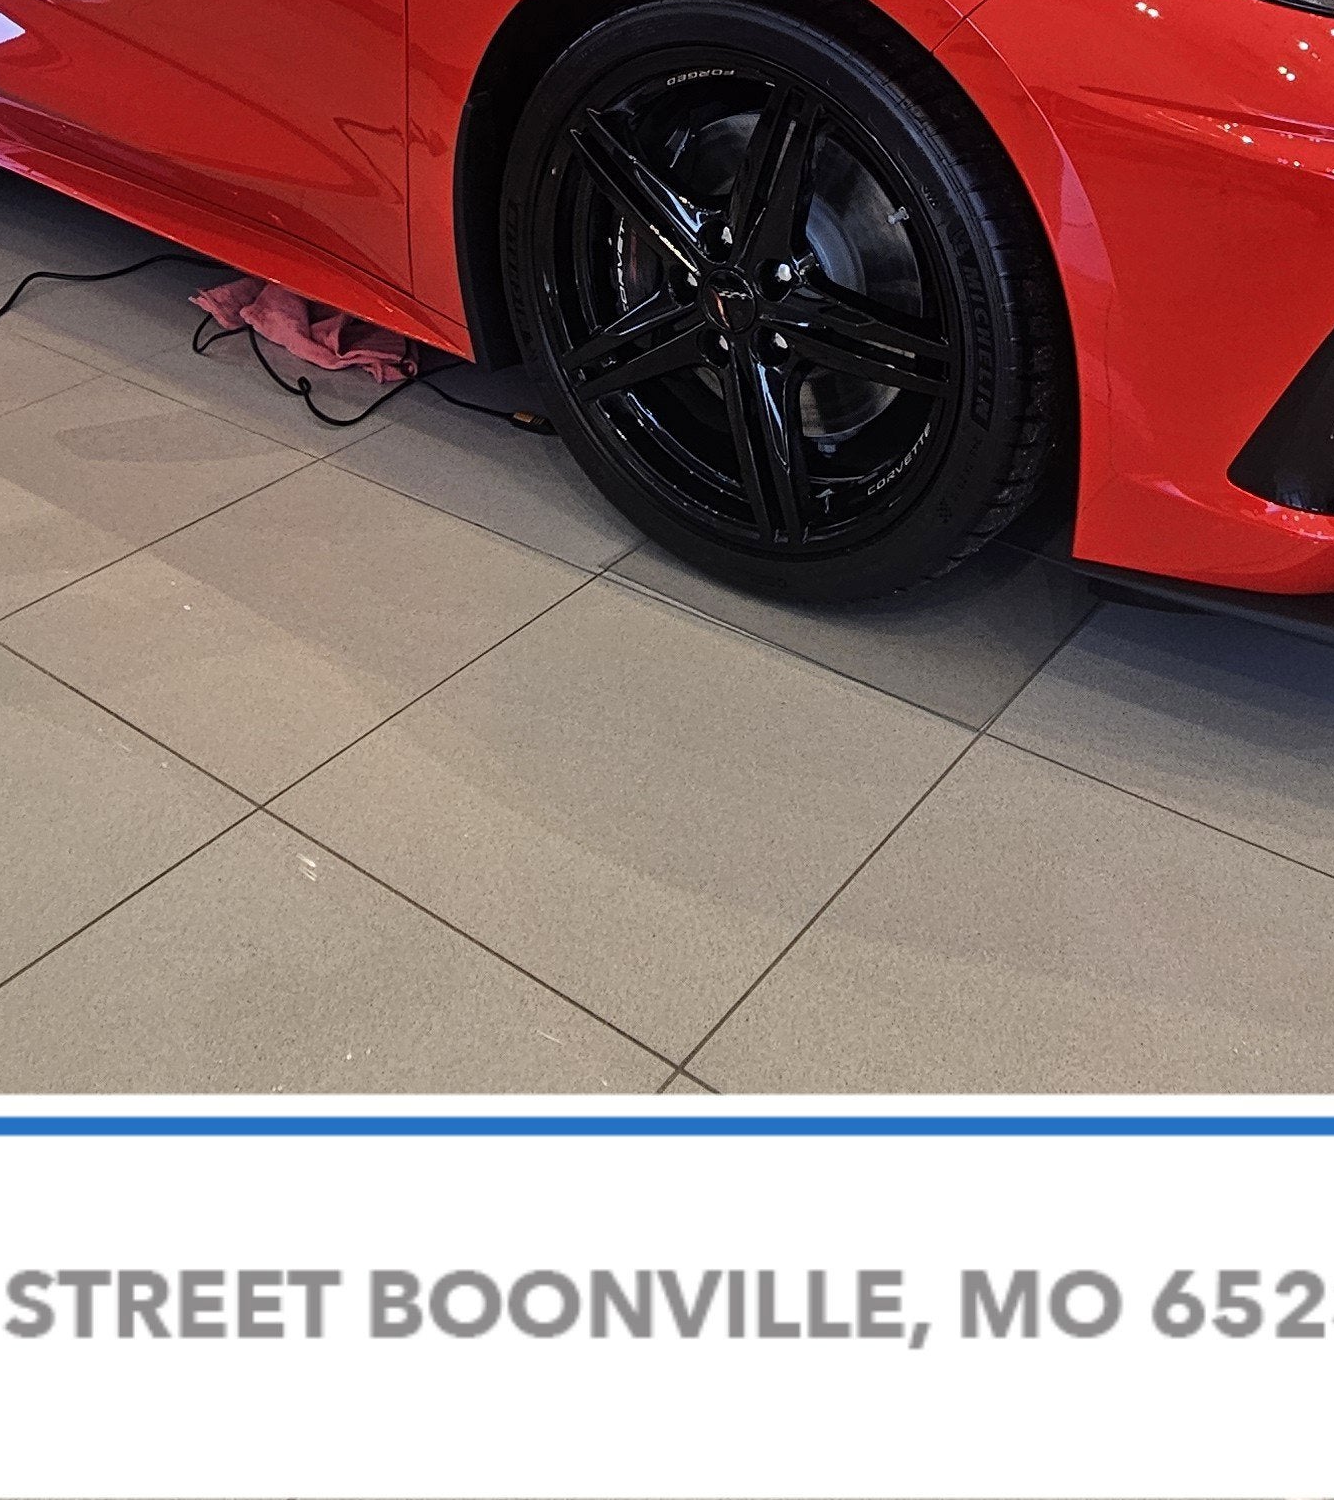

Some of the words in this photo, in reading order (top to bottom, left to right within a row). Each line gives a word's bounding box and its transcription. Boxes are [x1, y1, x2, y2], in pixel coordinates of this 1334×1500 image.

[666, 68, 735, 86] FORGED
[963, 265, 995, 426] MICHELIN
[867, 422, 931, 496] CORVETTE
